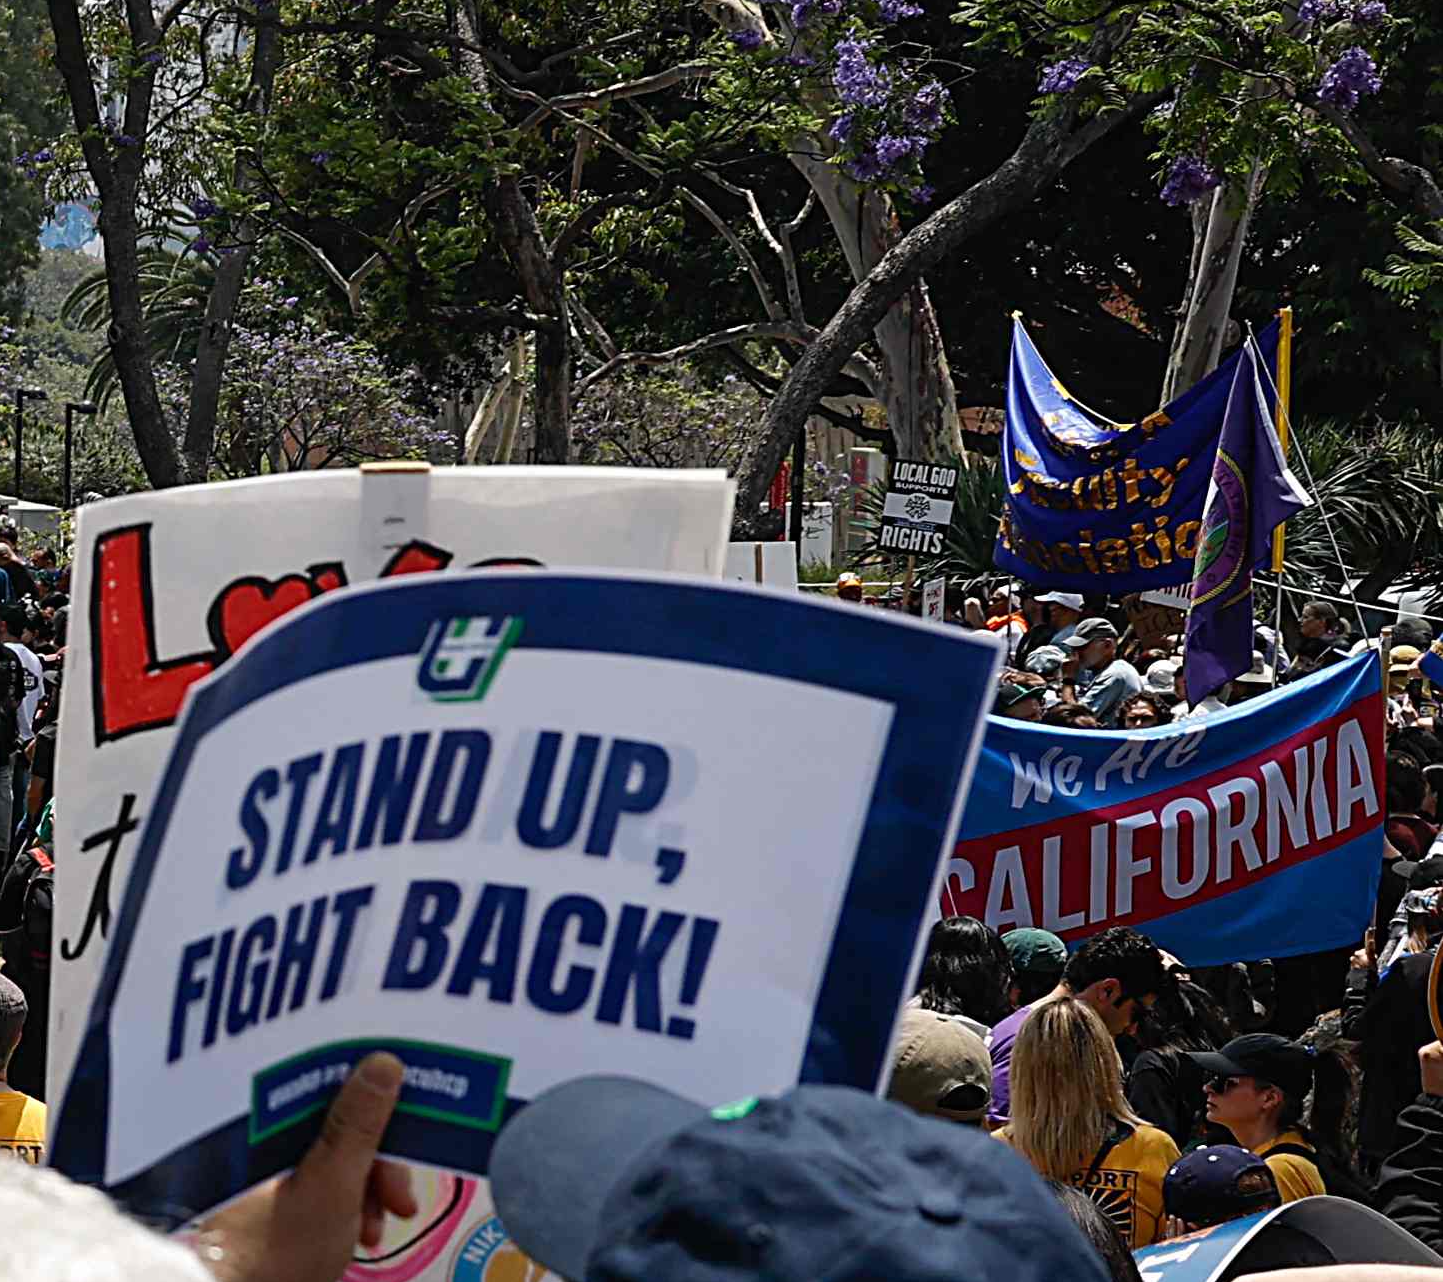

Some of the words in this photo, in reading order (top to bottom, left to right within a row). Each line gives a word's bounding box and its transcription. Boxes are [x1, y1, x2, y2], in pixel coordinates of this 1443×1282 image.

[893, 461, 931, 486] LOCAL
[931, 467, 956, 488] 600
[895, 481, 948, 495] SUPPORTS
[880, 525, 944, 555] RIGHTS
[1009, 744, 1084, 810] We
[1095, 727, 1209, 792] Are
[226, 727, 495, 891] STAND
[513, 729, 687, 887] UP,
[166, 885, 373, 1066] FIGHT
[382, 877, 720, 1042] BACK!
[464, 1218, 508, 1264] NIK
